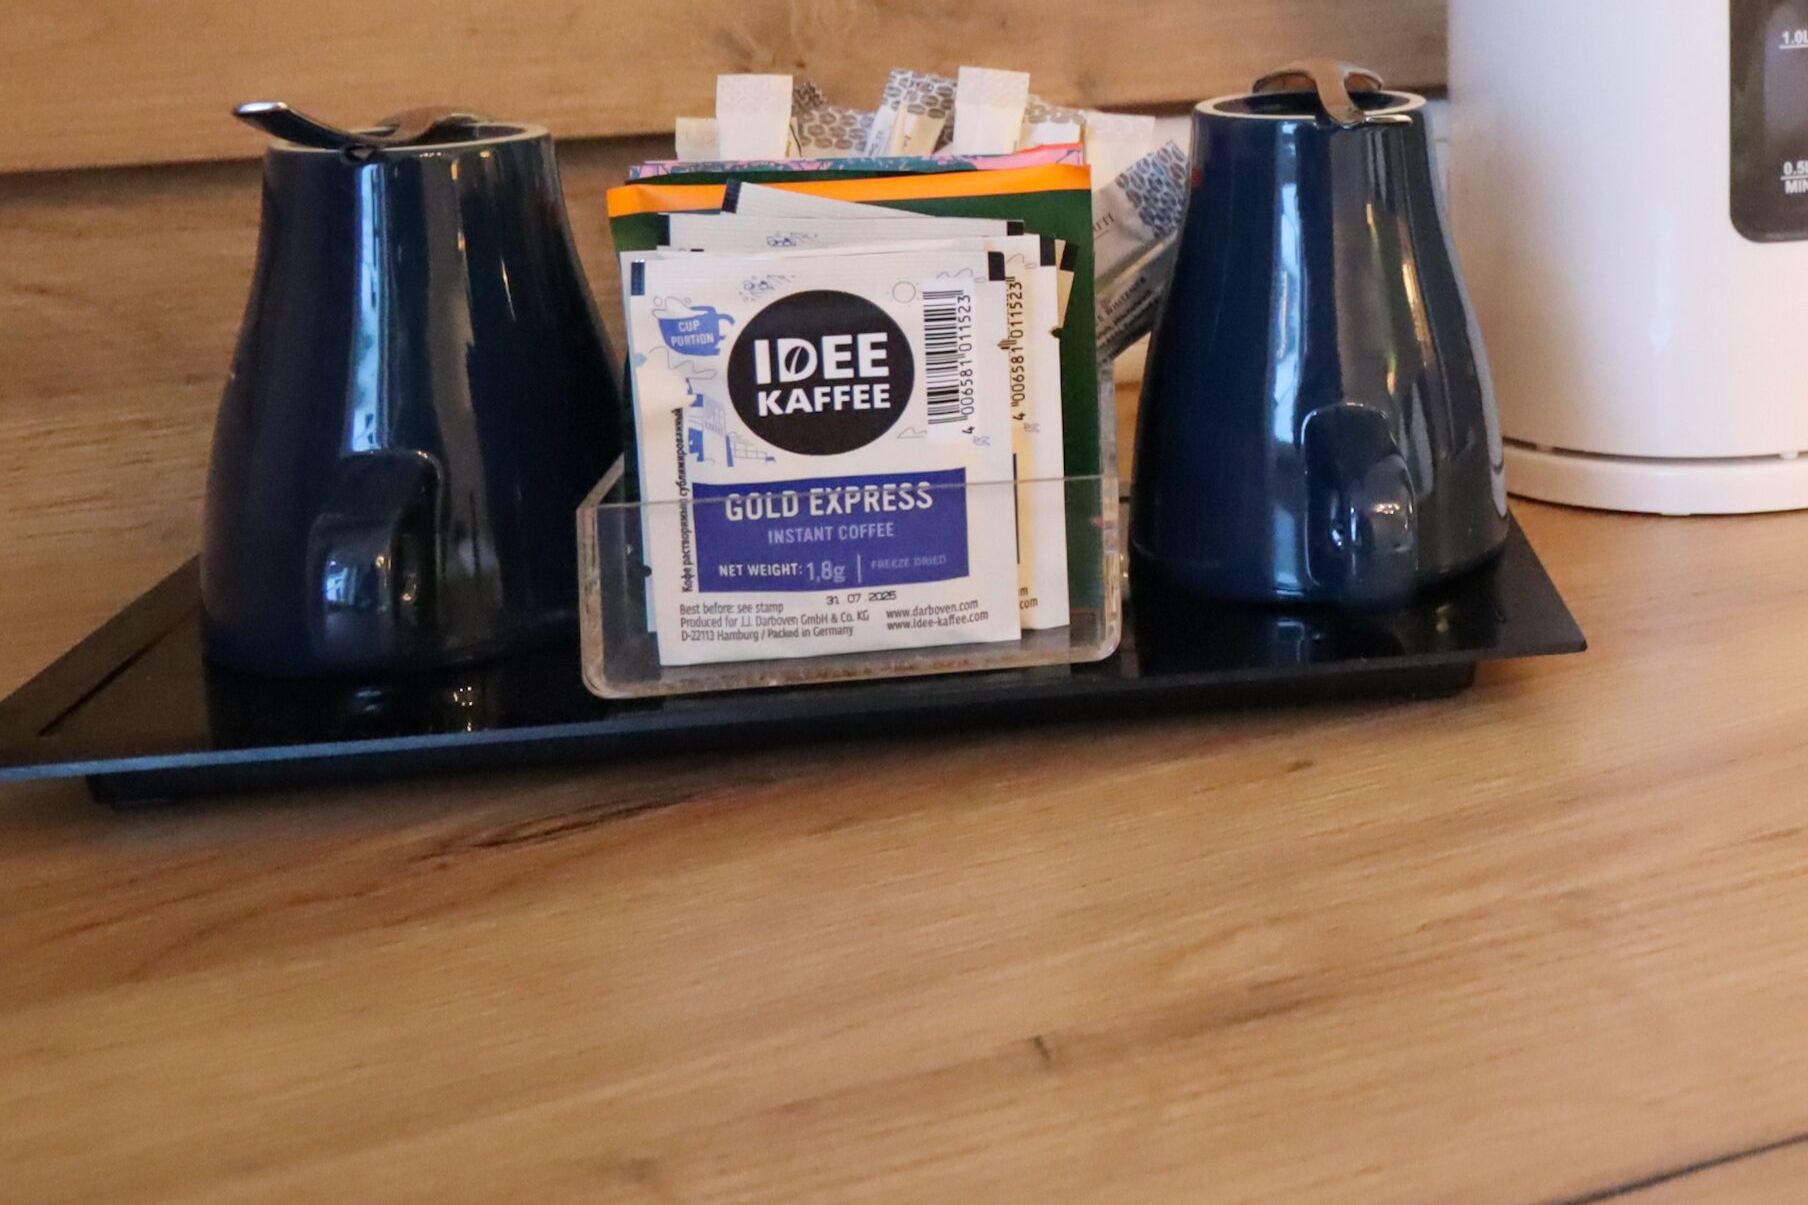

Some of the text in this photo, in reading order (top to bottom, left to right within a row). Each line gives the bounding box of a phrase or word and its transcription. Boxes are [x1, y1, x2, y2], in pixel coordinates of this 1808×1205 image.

[678, 320, 700, 332] CUP
[671, 333, 714, 347] PORTION
[1009, 281, 1026, 421] 4 006581 011523
[754, 332, 890, 384] IDEE
[957, 294, 976, 435] 4 006581 011523
[758, 383, 892, 417] KAFFEE
[725, 481, 934, 522] GOLD EXPRESS
[768, 522, 894, 545] INSTANT COFFEE
[681, 567, 695, 593] Кофе
[718, 560, 846, 584] NET WEIGHT: 1,8g
[680, 603, 700, 615] Best
[736, 604, 753, 614] see
[755, 602, 784, 615] stamp
[826, 595, 840, 605] 31
[847, 593, 862, 604] 07
[886, 599, 979, 619] www.darboven.com
[680, 616, 722, 629] Produced
[725, 615, 738, 627] for
[756, 614, 798, 627] Darboven
[800, 613, 829, 626] GmbH
[830, 613, 838, 624] &
[840, 611, 855, 623] Co.
[856, 609, 870, 621] KG
[887, 610, 989, 631] www.idee-kaffee.com
[681, 630, 715, 642] D-22113
[717, 628, 759, 642] Hamburg
[767, 626, 799, 639] Packed
[801, 626, 811, 638] in
[813, 625, 854, 639] Germany
